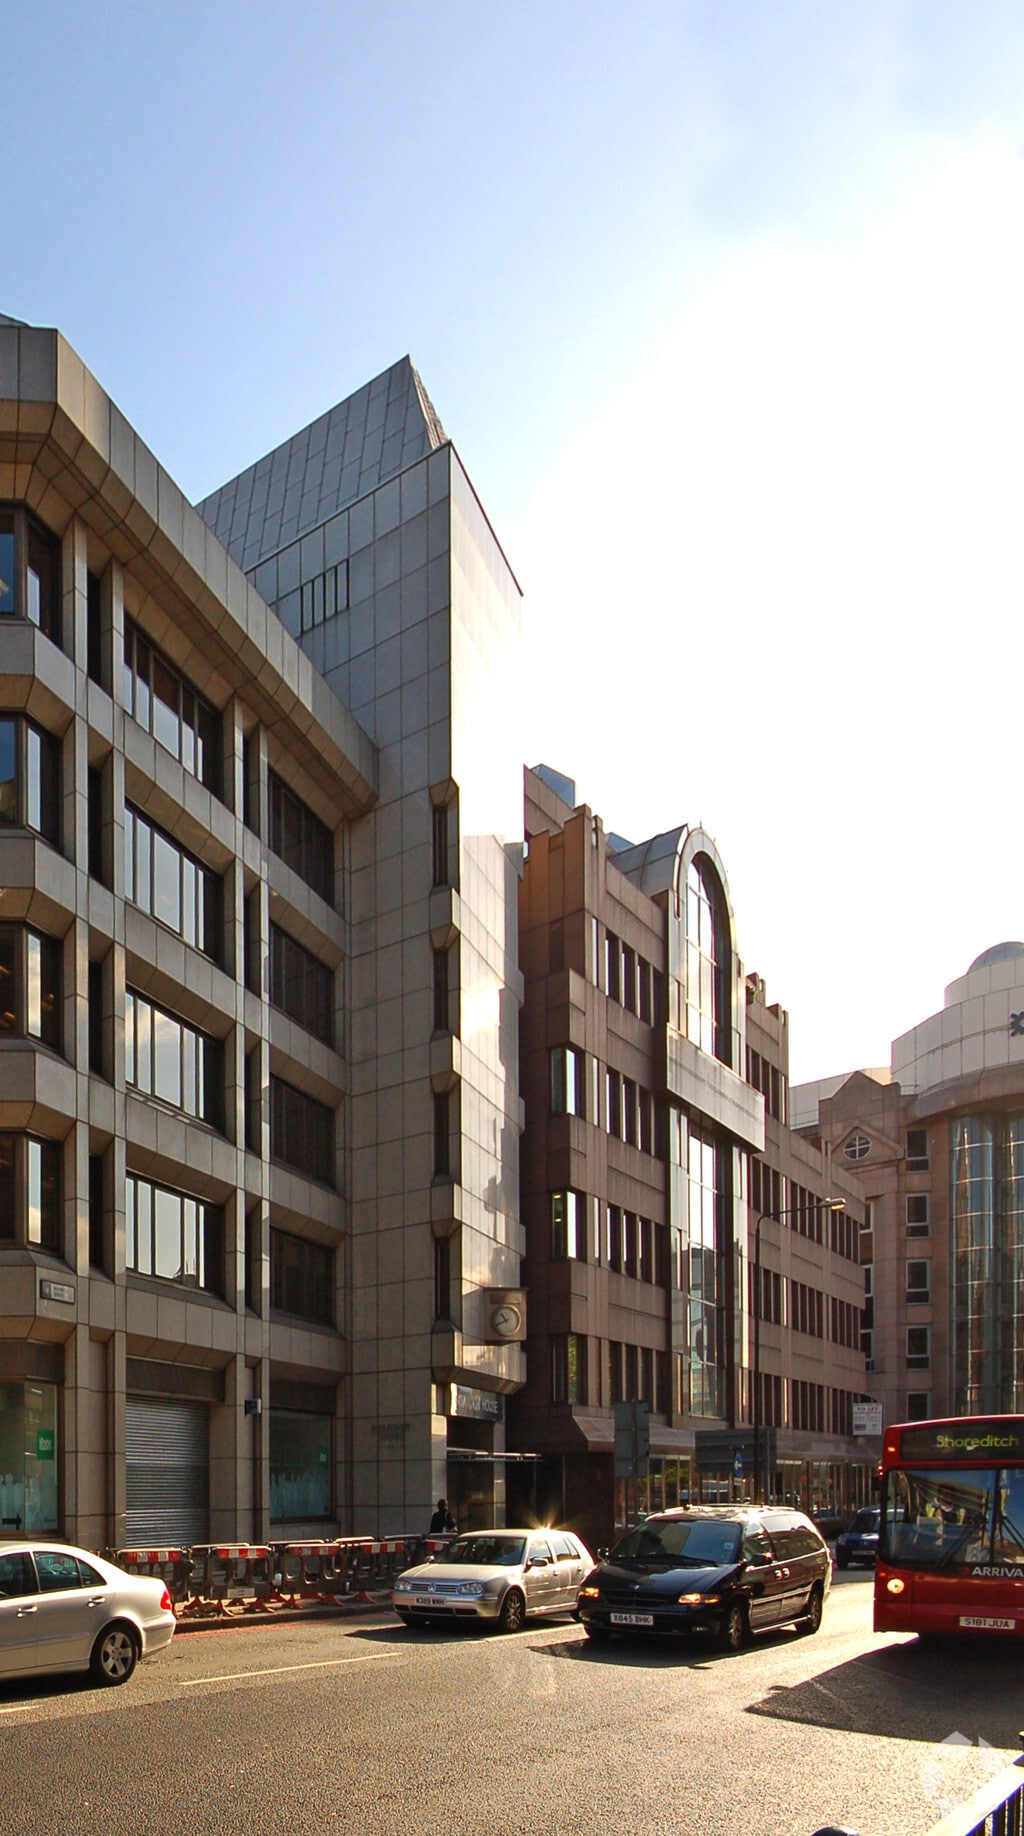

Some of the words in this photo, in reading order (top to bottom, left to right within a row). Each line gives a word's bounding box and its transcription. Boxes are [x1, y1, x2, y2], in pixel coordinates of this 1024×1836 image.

[936, 1434, 1020, 1447] Shoreditch
[972, 1566, 1024, 1577] ARRIVA
[613, 1614, 634, 1622] X845
[635, 1615, 650, 1623] BHK
[964, 1617, 986, 1626] S181
[988, 1619, 1010, 1628] JUA
